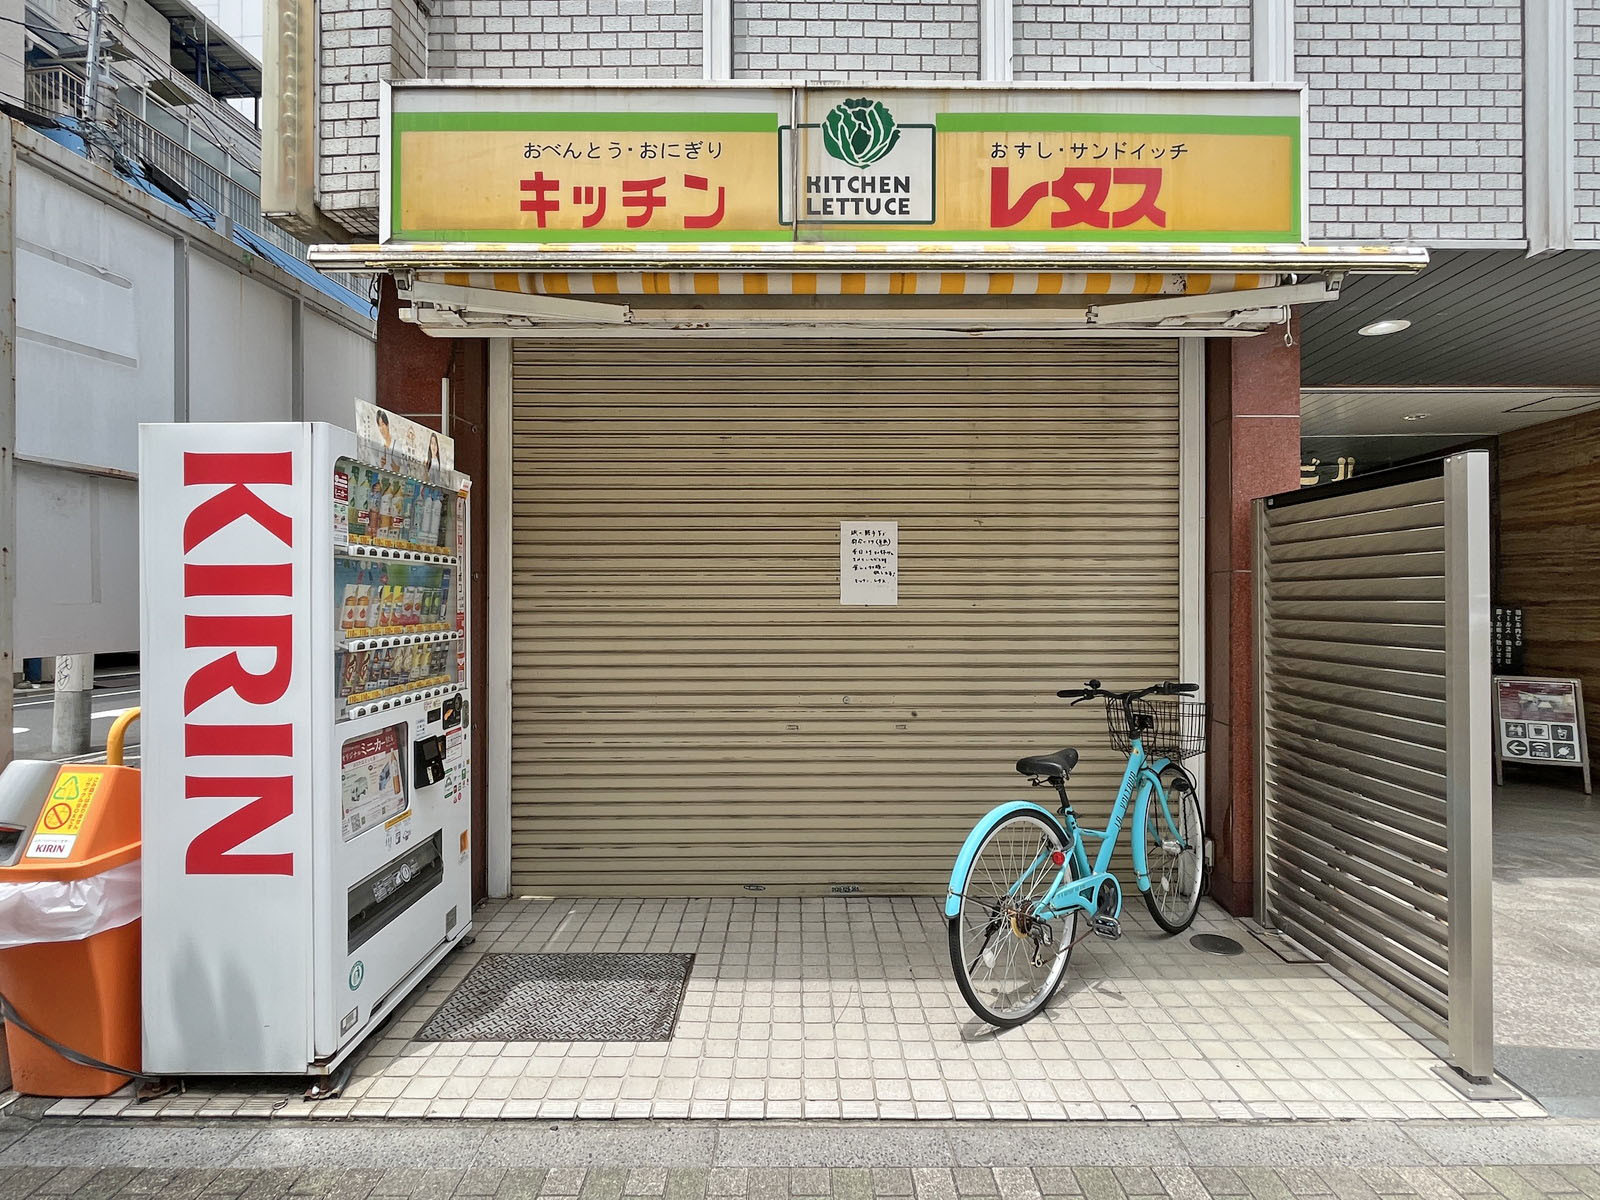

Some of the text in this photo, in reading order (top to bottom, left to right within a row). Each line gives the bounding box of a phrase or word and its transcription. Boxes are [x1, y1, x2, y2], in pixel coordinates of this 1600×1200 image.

[523, 141, 723, 160] おべんとう・おにぎり
[990, 141, 1189, 160] おすし・サンドイッチ
[806, 175, 911, 194] KITCHEN
[520, 171, 726, 229] キッチン
[806, 197, 911, 216] LETTUCE
[990, 167, 1167, 228] レタス
[183, 451, 294, 876] KIRIN
[35, 843, 66, 853] KIRIN
